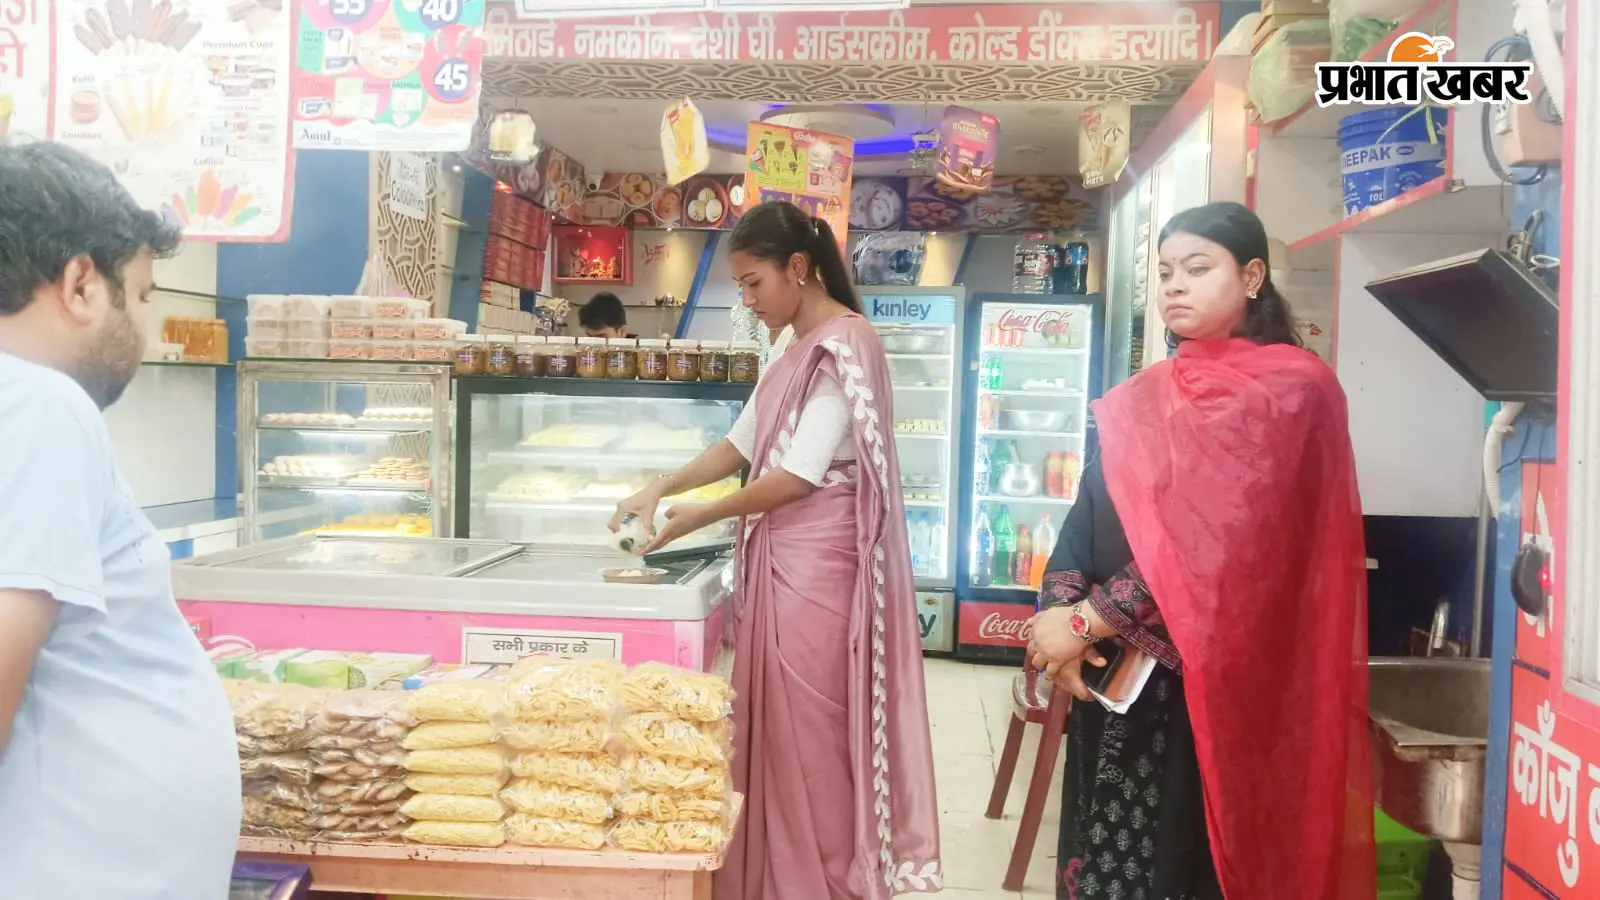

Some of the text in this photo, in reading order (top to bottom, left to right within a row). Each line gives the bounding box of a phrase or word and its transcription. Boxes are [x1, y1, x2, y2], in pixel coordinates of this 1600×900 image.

[423, 0, 458, 21] 40
[203, 40, 274, 50] Premium Cups
[690, 12, 740, 59] देशी
[948, 11, 1021, 60] कोल्ड
[434, 63, 469, 91] 45
[301, 128, 332, 141] Amul
[873, 299, 932, 320] kinley
[979, 612, 1034, 641] Coca-C
[492, 637, 589, 654] सभी प्रकार के
